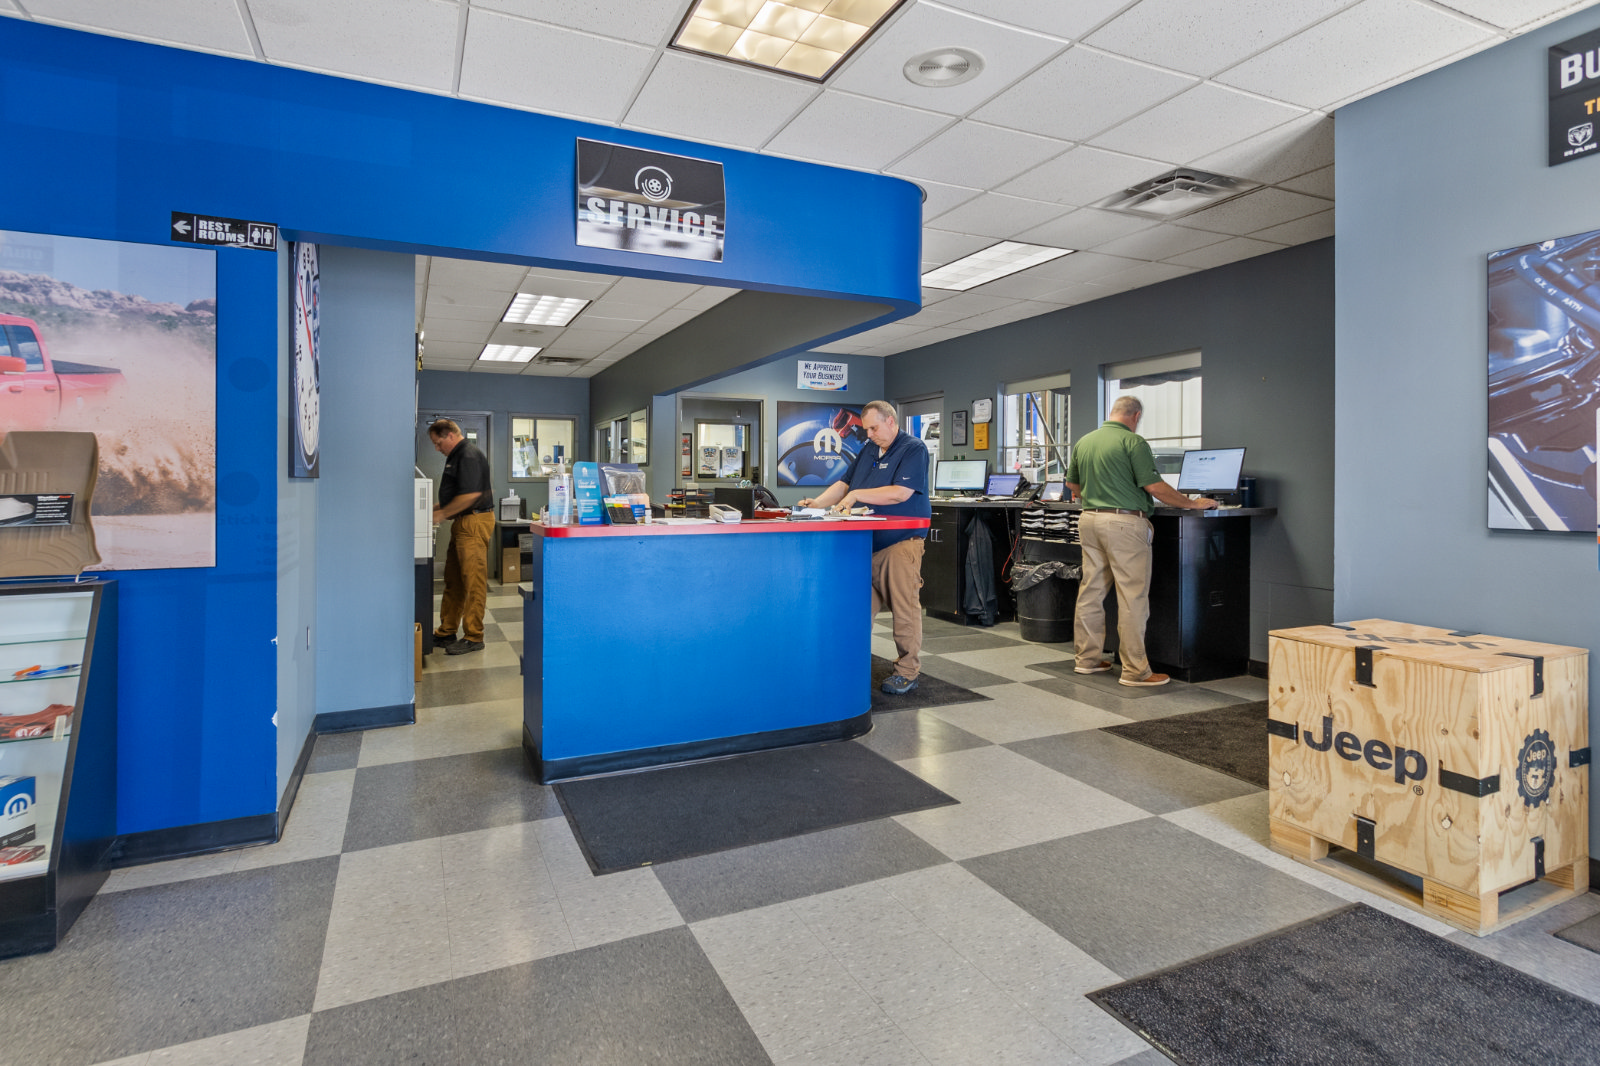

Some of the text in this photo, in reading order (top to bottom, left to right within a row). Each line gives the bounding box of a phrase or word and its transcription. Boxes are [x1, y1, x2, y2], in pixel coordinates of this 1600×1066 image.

[1563, 142, 1598, 157] RAM
[198, 219, 231, 233] REST
[586, 197, 718, 241] SERVICE
[198, 229, 245, 243] ROOMS
[804, 362, 842, 373] WE APPRECIATE
[803, 371, 844, 381] YOUR BUSINESS!
[1345, 633, 1499, 650] Jeep
[1303, 715, 1428, 785] Jeep
[1526, 749, 1547, 763] Jeep
